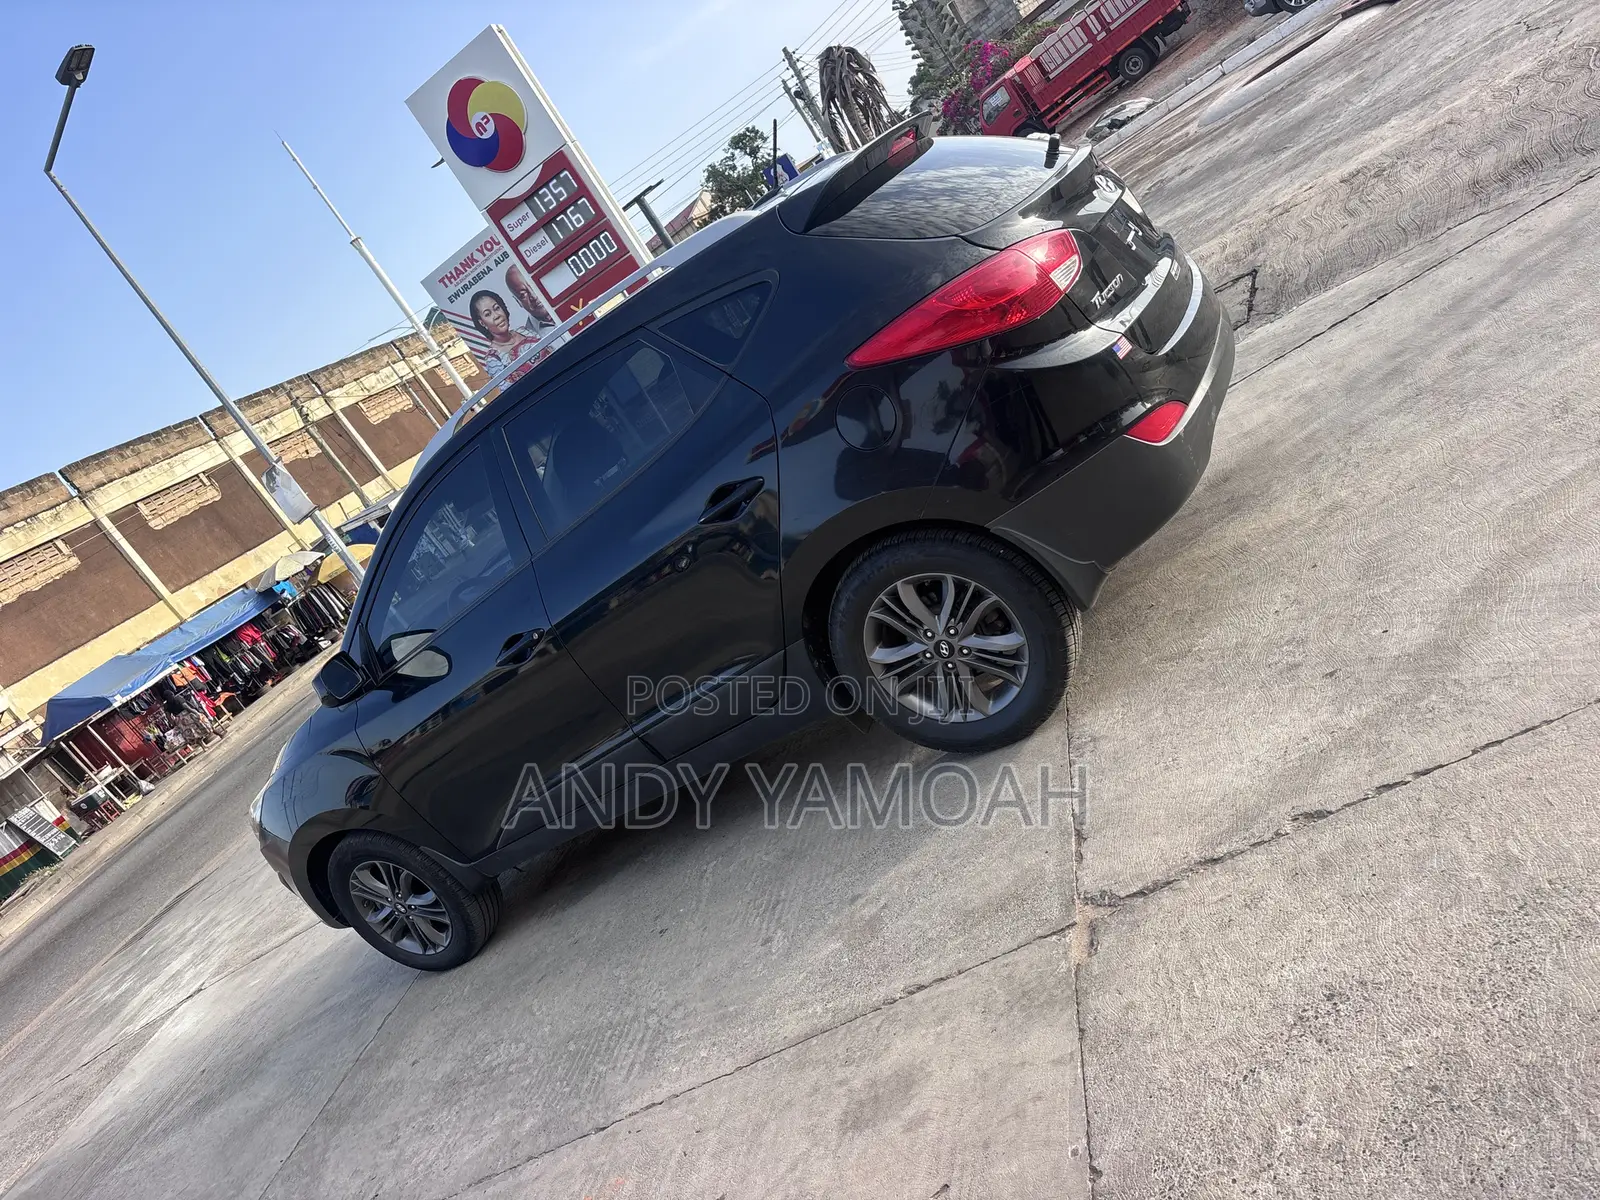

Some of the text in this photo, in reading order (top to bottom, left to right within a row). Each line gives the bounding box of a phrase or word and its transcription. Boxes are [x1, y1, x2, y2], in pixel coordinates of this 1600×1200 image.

[507, 170, 578, 233] Super 1357
[523, 197, 595, 258] Diesel 1767
[438, 233, 502, 289] THANK YOU
[567, 231, 618, 277] 0000
[447, 265, 493, 304] EWURABENA
[1090, 273, 1124, 310] Tucson
